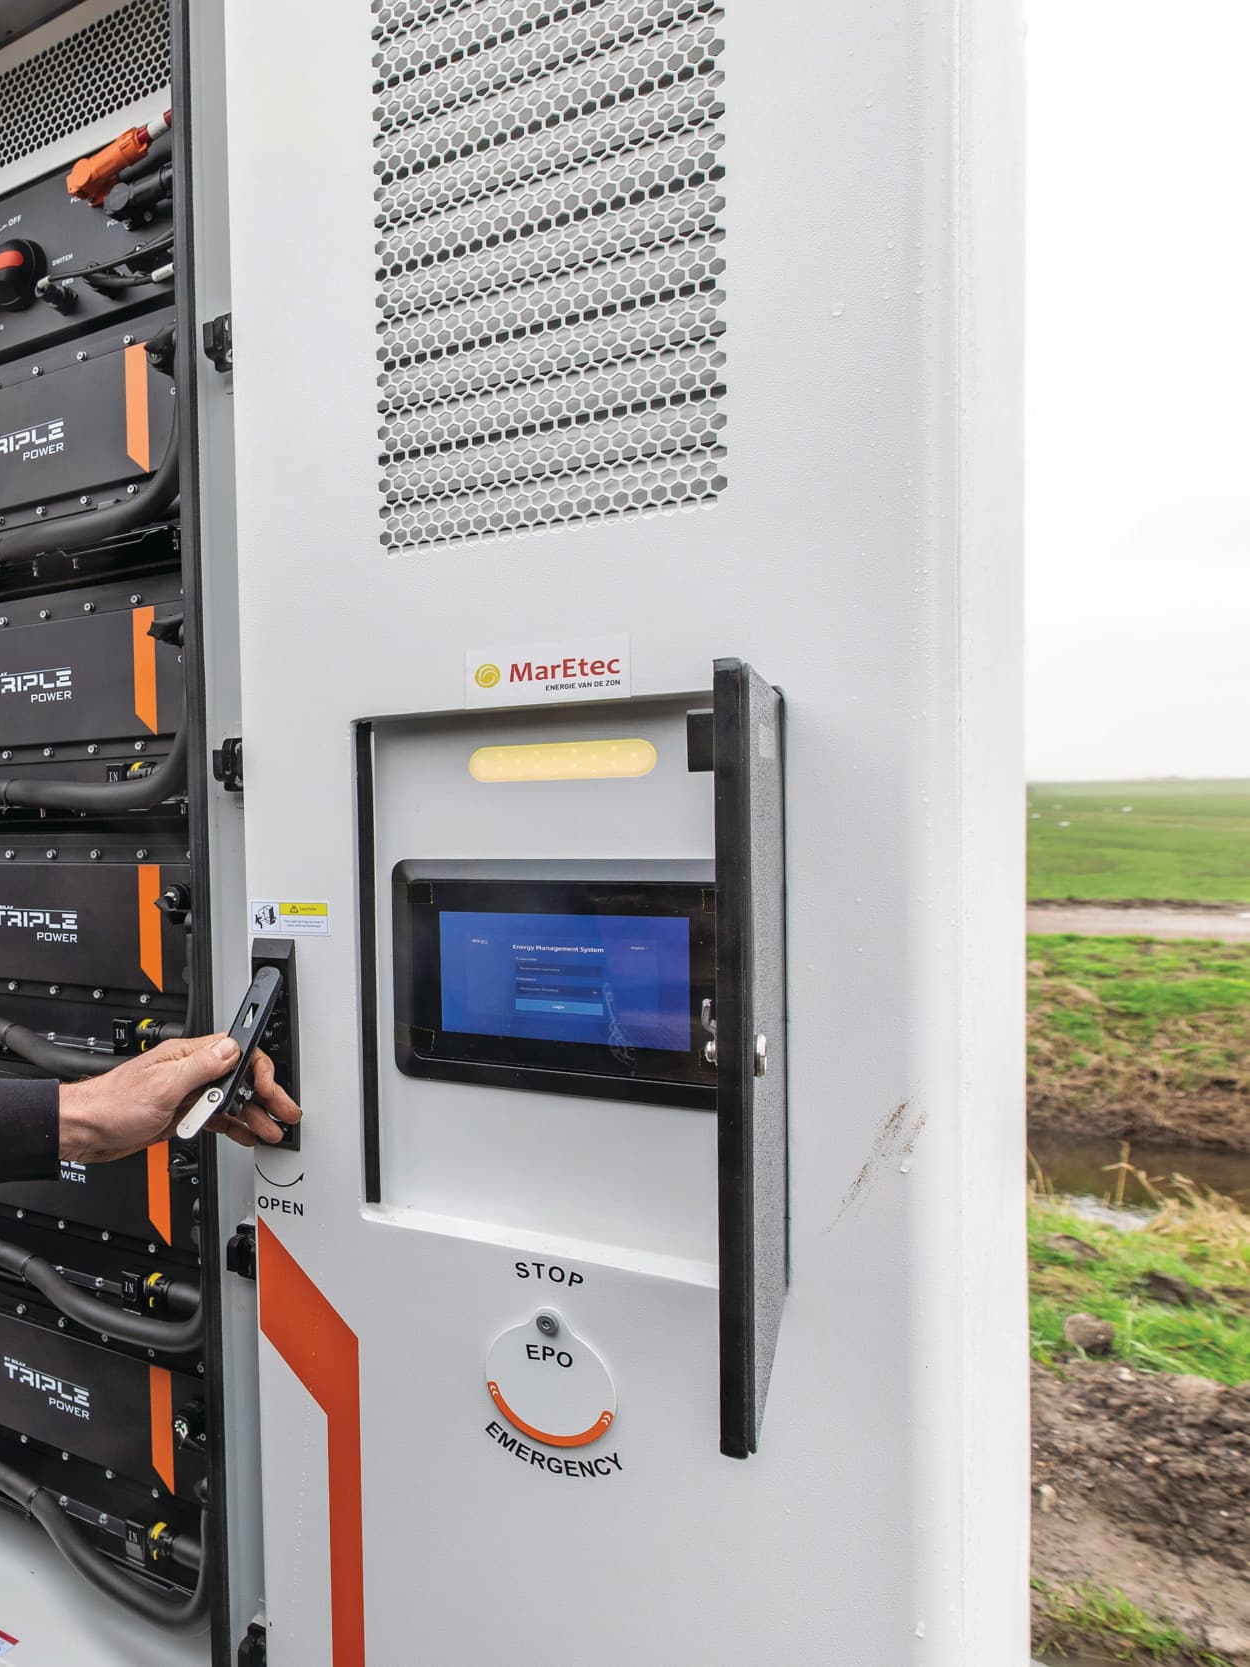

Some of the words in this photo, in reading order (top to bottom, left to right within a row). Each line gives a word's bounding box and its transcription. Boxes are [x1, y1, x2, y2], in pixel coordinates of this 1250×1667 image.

[8, 214, 22, 227] OFF
[51, 253, 73, 267] SWITCH
[22, 442, 64, 461] POWER
[509, 657, 621, 683] MarEtec
[545, 683, 576, 691] ENERGIE
[577, 681, 592, 689] VAN
[605, 679, 621, 687] ZON
[30, 690, 72, 703] POWER
[110, 771, 118, 783] IN
[36, 932, 78, 943] POWER
[512, 944, 535, 952] Energy
[535, 945, 579, 953] Management
[580, 946, 605, 954] System
[115, 1028, 126, 1040] IN
[60, 1169, 86, 1184] WER
[257, 1195, 304, 1217] OPEN
[514, 1262, 584, 1287] STOP
[124, 1281, 134, 1294] IN
[526, 1343, 573, 1368] EPO
[4, 1361, 90, 1408] TRIPLE
[48, 1397, 90, 1420] POWER
[485, 1420, 623, 1478] EMERGENCY
